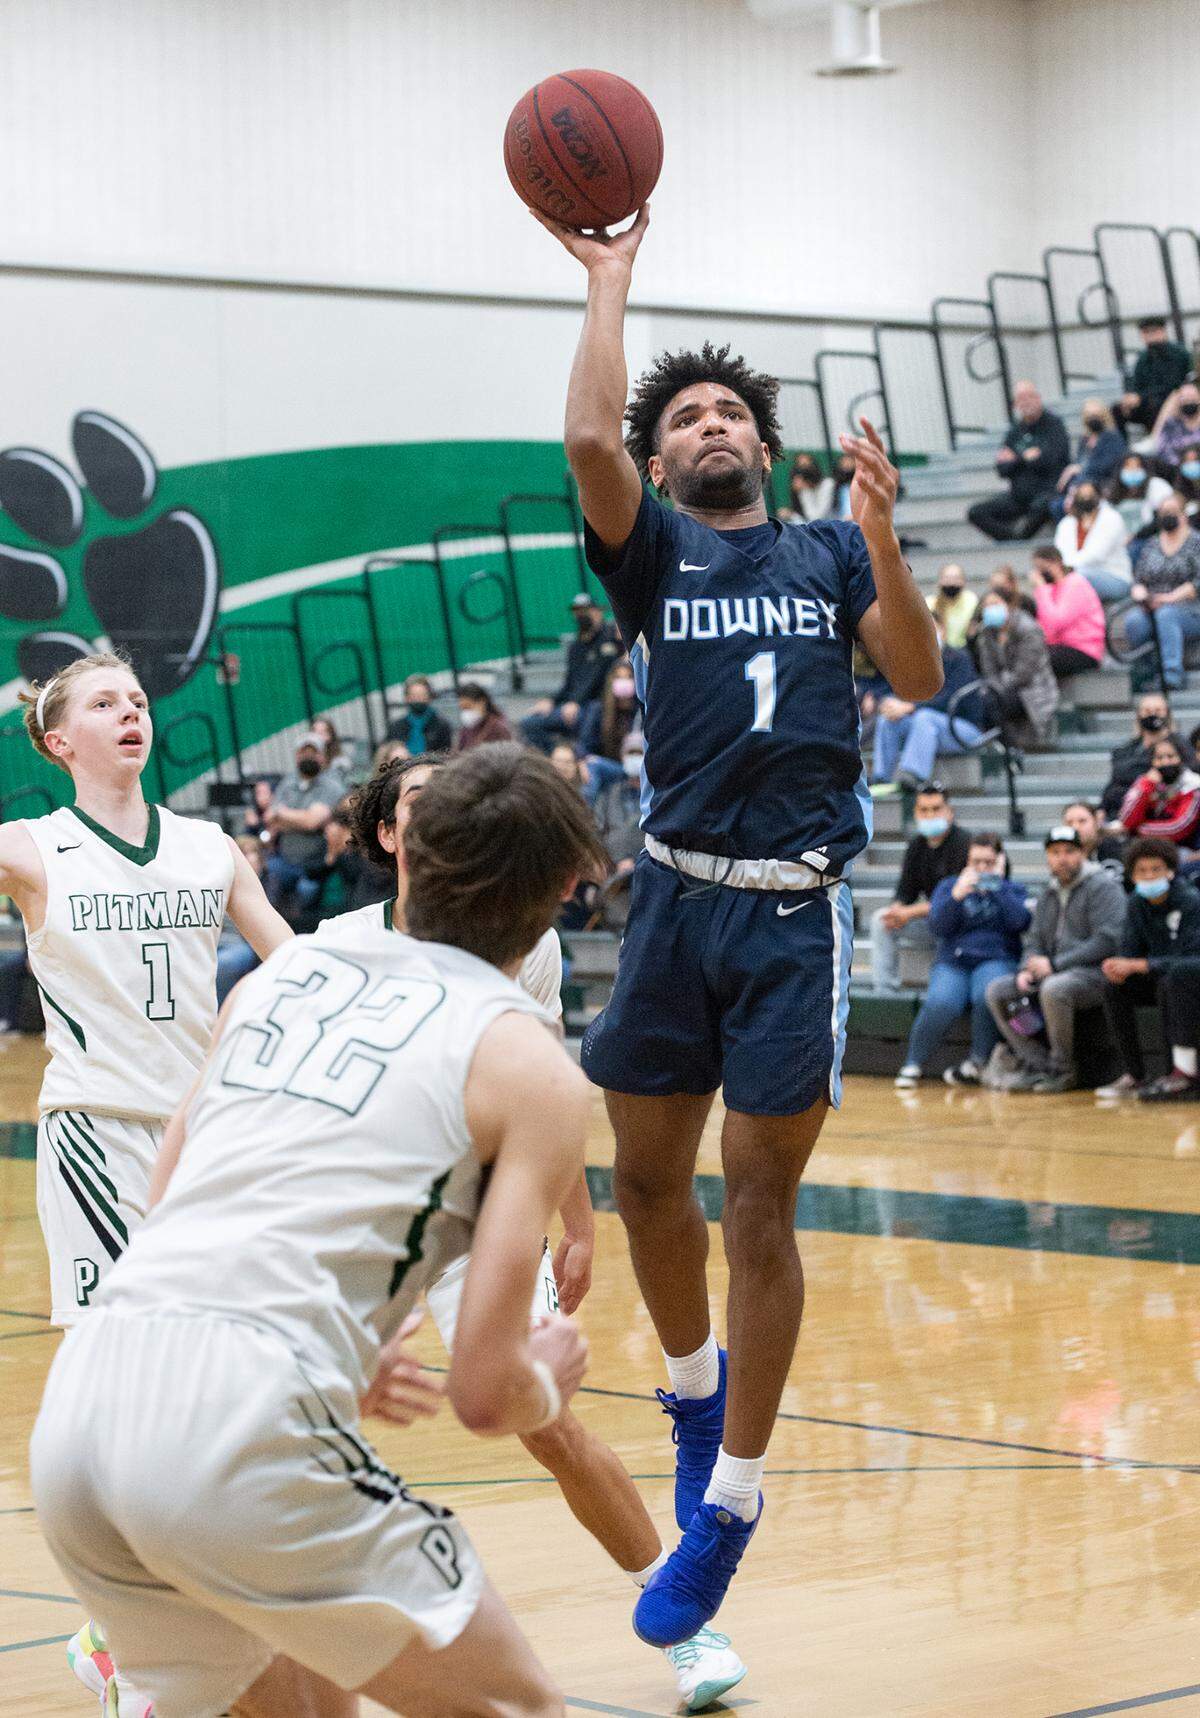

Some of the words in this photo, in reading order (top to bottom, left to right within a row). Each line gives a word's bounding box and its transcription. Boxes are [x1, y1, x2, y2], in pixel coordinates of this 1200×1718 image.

[663, 596, 841, 641] DOWNEY
[744, 651, 777, 733] 1
[69, 889, 224, 931] PITMAN
[142, 942, 175, 1021] 1
[221, 946, 446, 1118] 32
[73, 1257, 99, 1306] P
[418, 1524, 462, 1590] P
